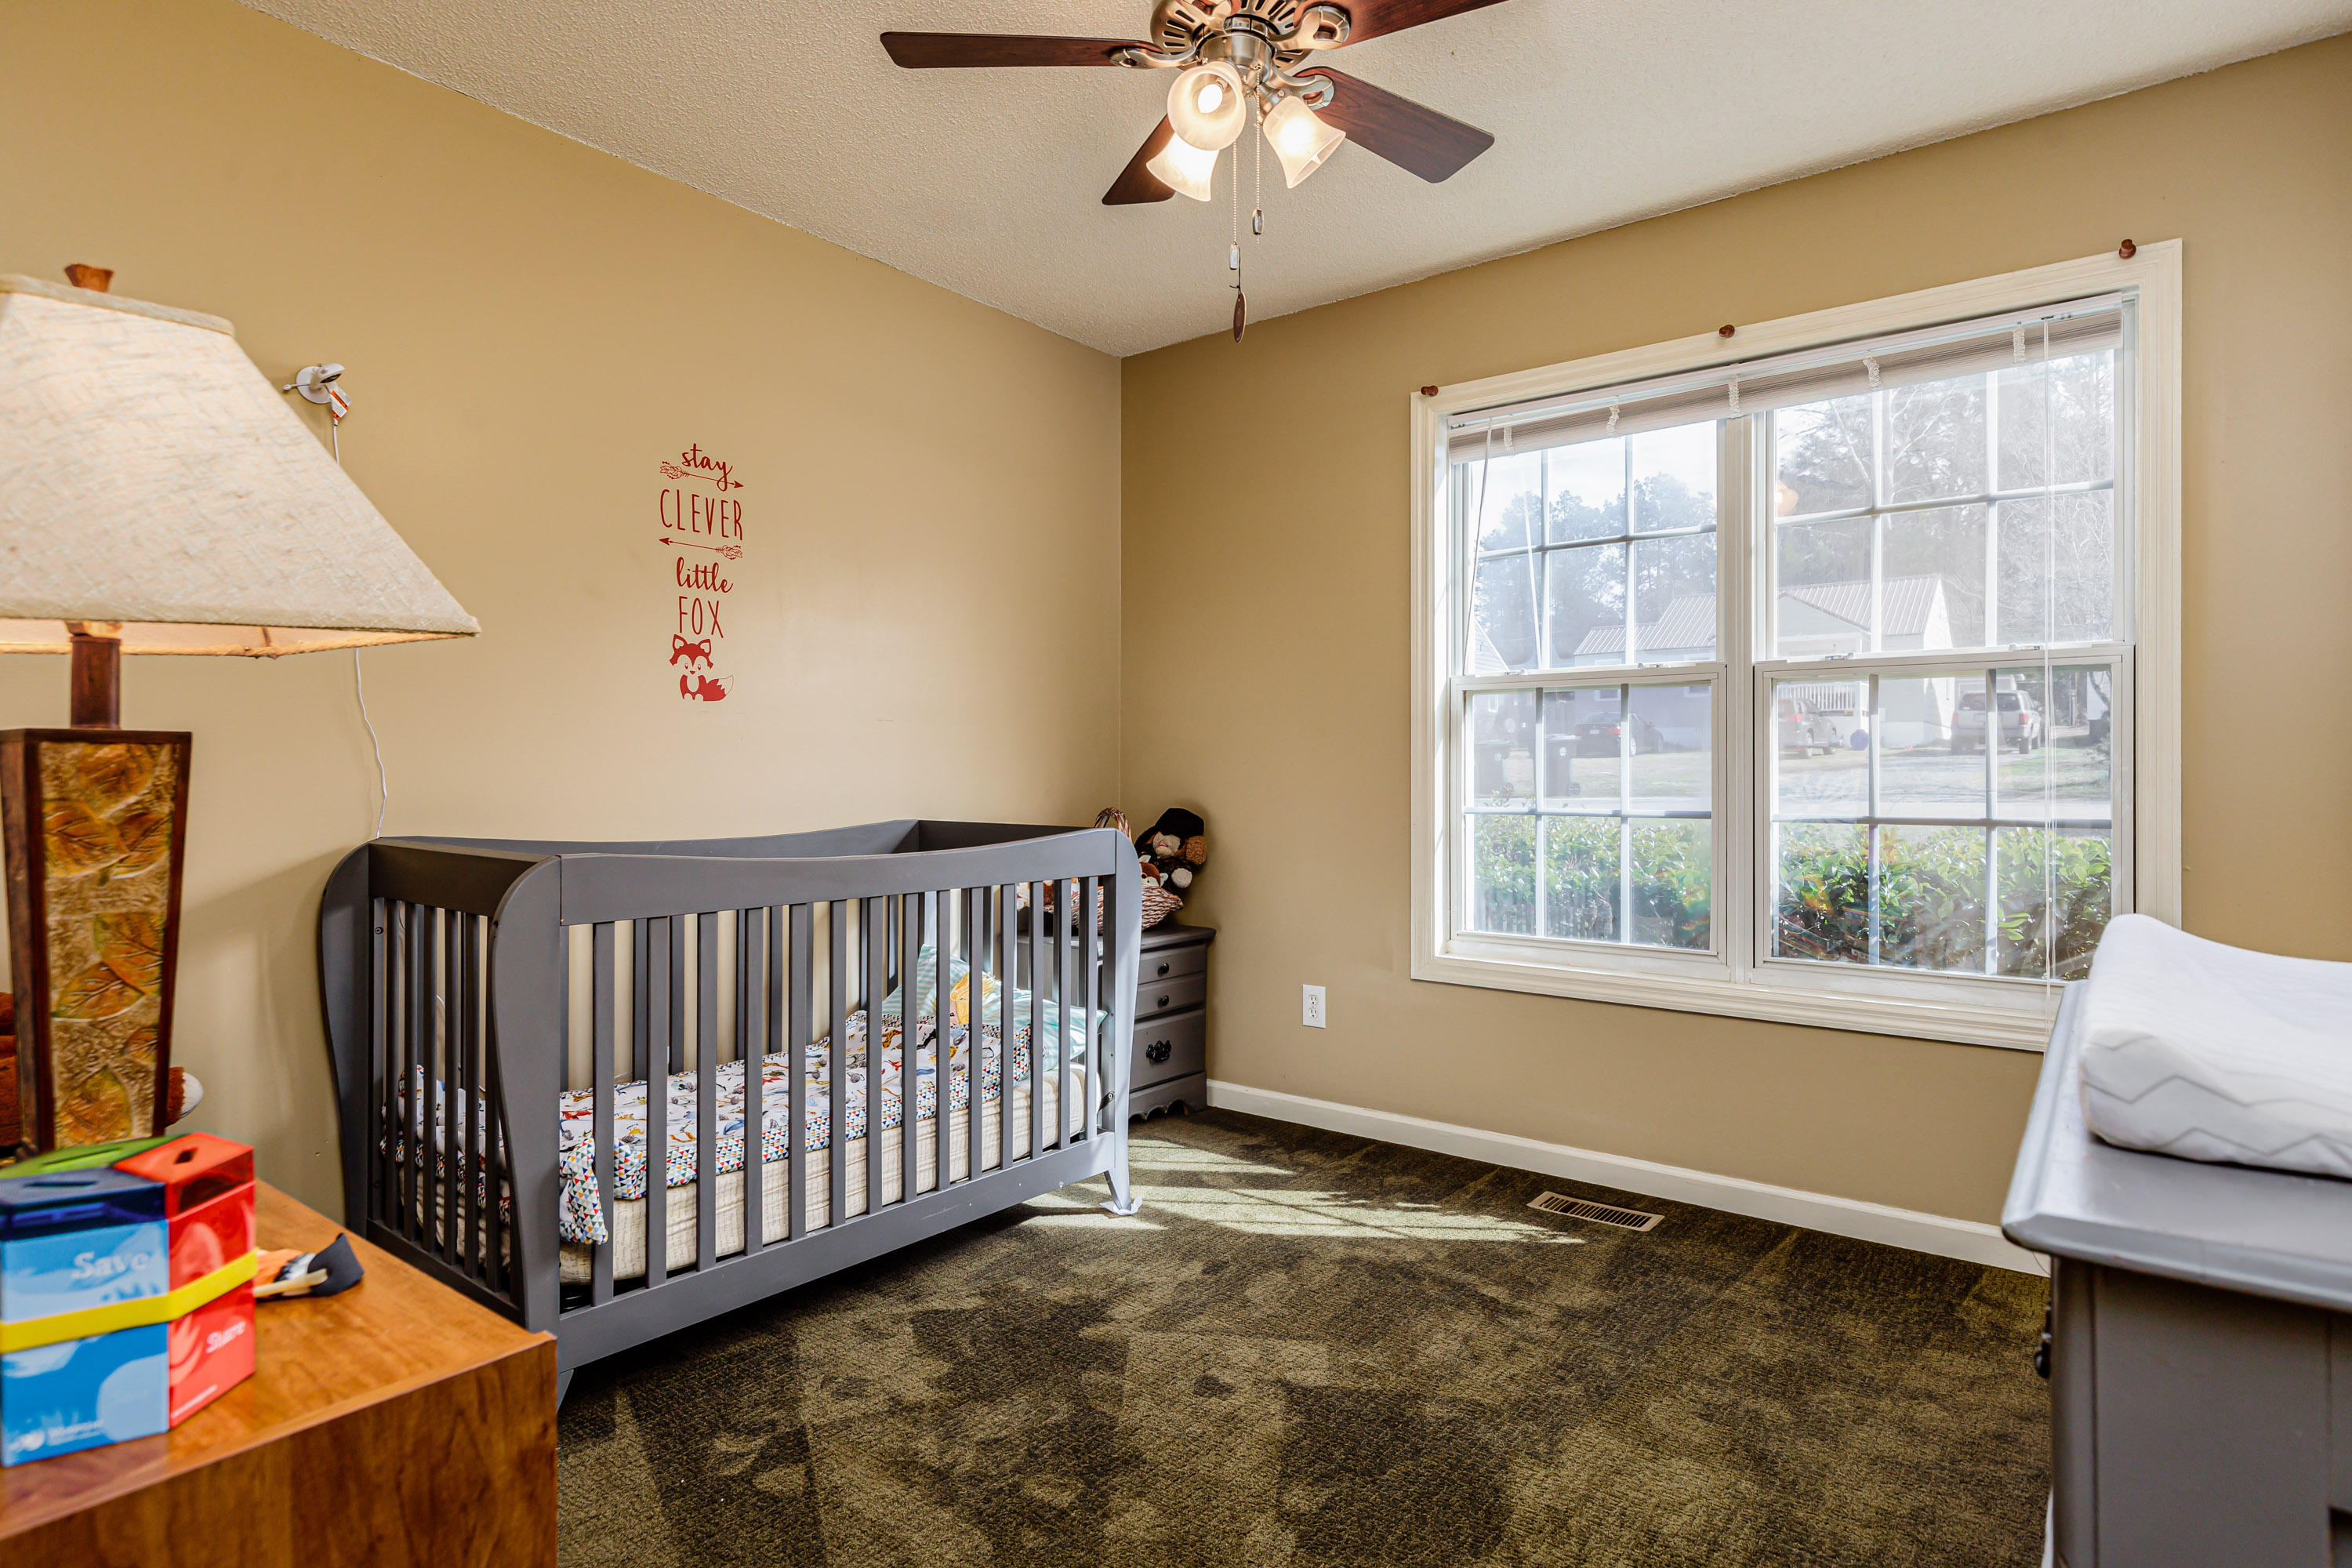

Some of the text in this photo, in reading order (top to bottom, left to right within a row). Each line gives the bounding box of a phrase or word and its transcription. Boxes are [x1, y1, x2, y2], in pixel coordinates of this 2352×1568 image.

[681, 443, 733, 492] stay
[659, 488, 743, 541] CLEVER
[676, 556, 734, 593] little
[678, 595, 724, 638] FOX
[71, 1251, 149, 1279] Save
